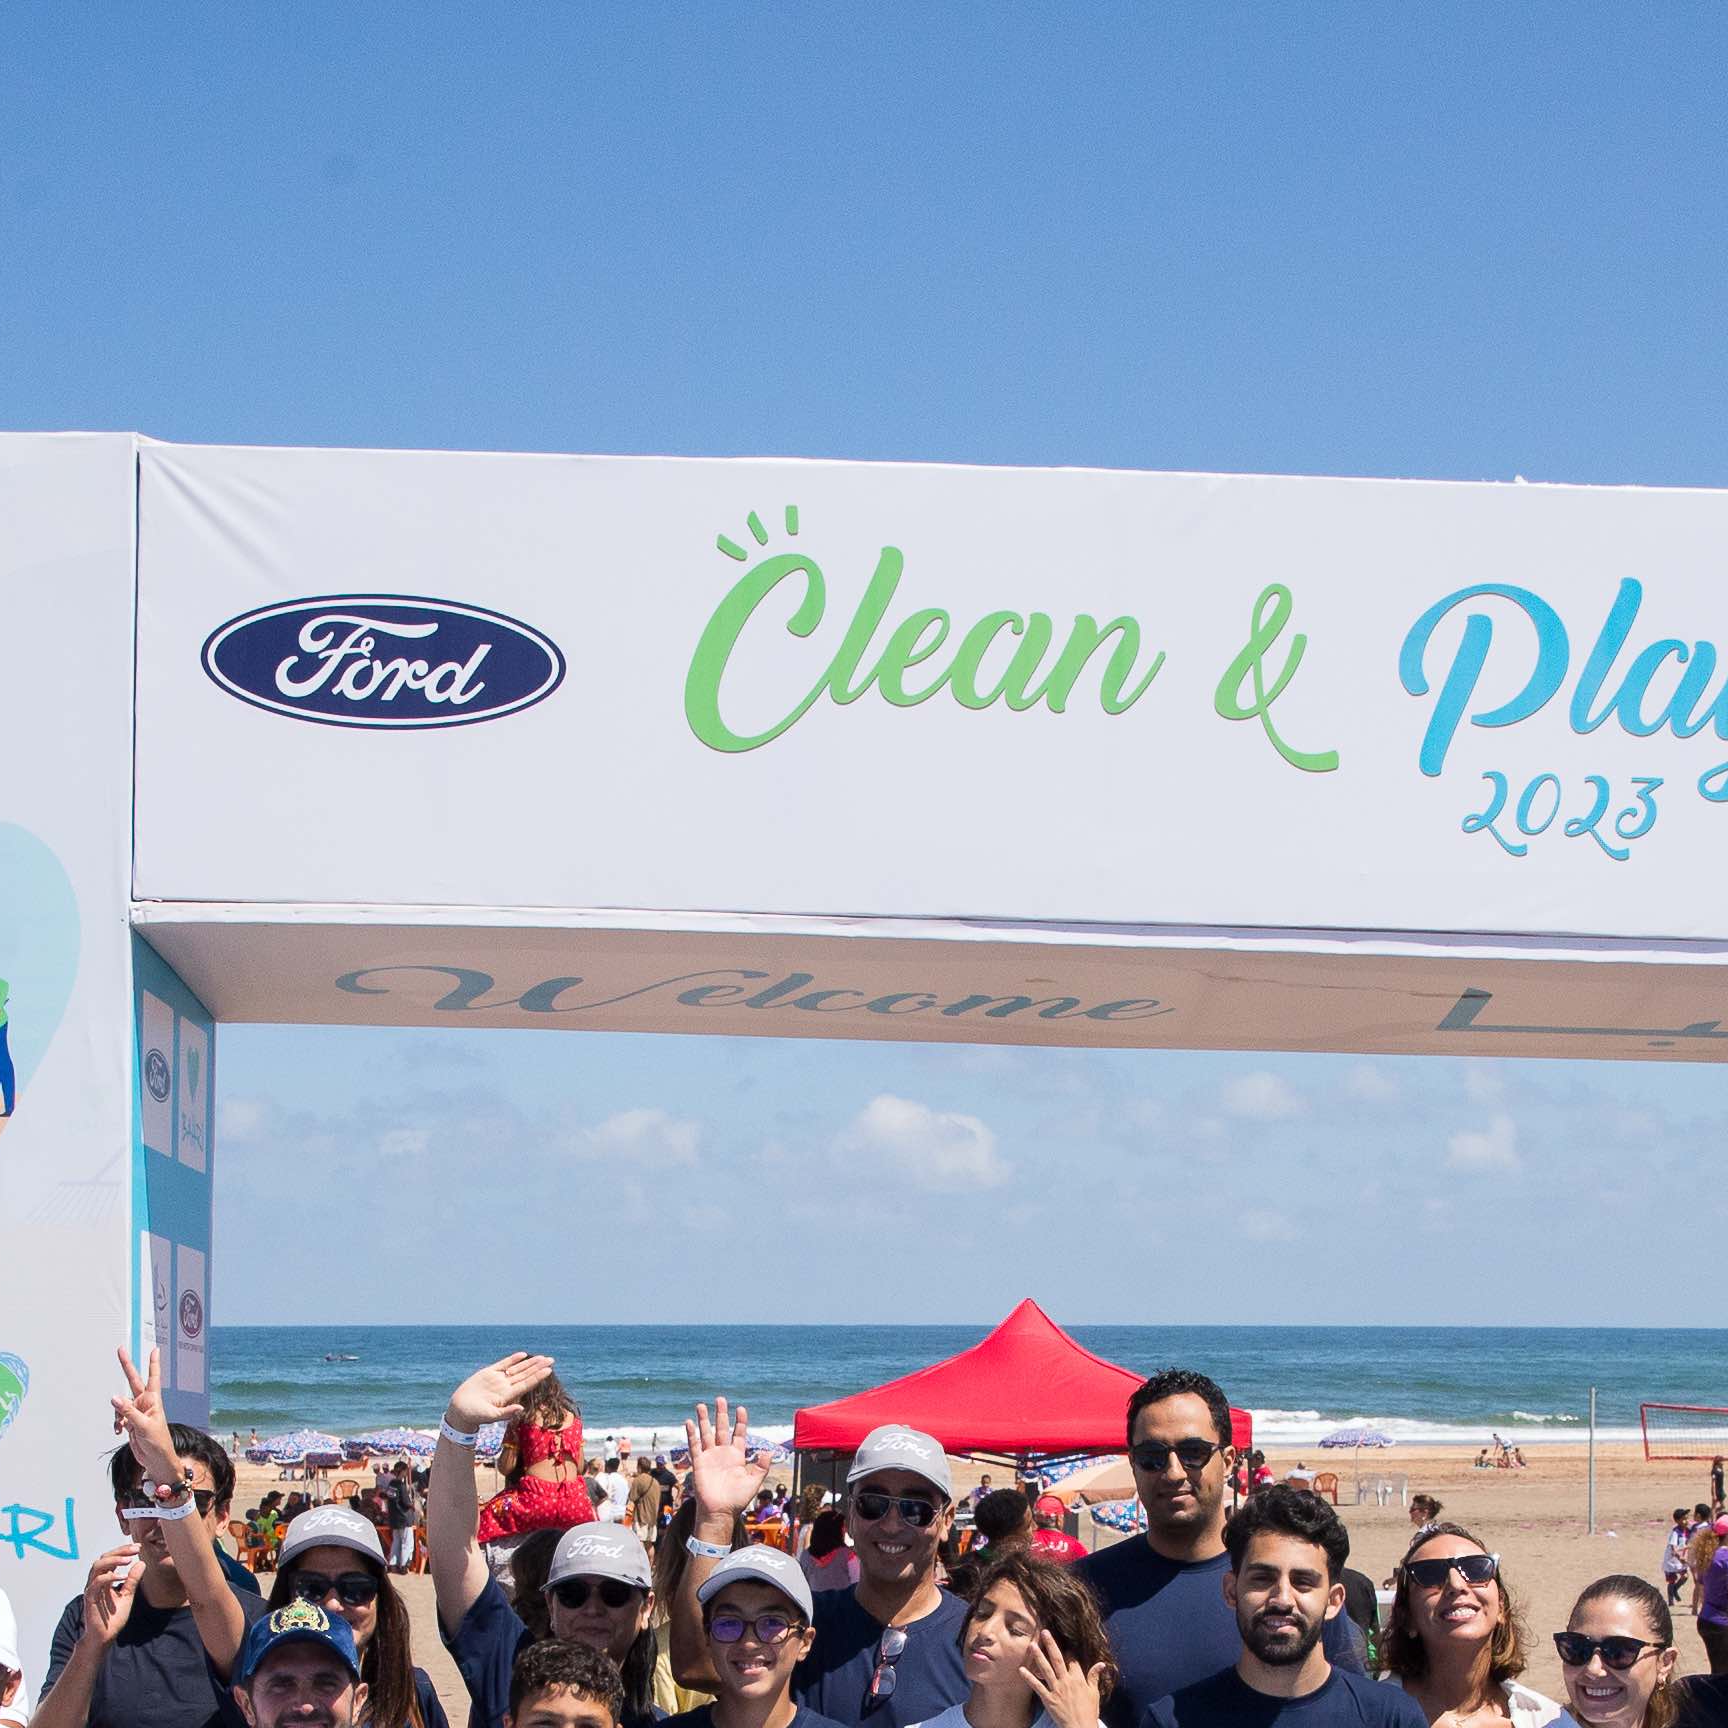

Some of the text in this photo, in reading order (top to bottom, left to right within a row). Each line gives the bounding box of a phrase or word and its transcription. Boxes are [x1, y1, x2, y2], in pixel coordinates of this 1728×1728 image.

[277, 613, 491, 705] Ford
[685, 546, 1165, 753] Clean
[1213, 583, 1339, 772] &
[1461, 771, 1664, 860] 2023
[335, 964, 1174, 1021] Welcome
[874, 1433, 932, 1460] Ford
[304, 1509, 363, 1532] Ford
[566, 1535, 624, 1560] Ford
[721, 1548, 788, 1571] Ford
